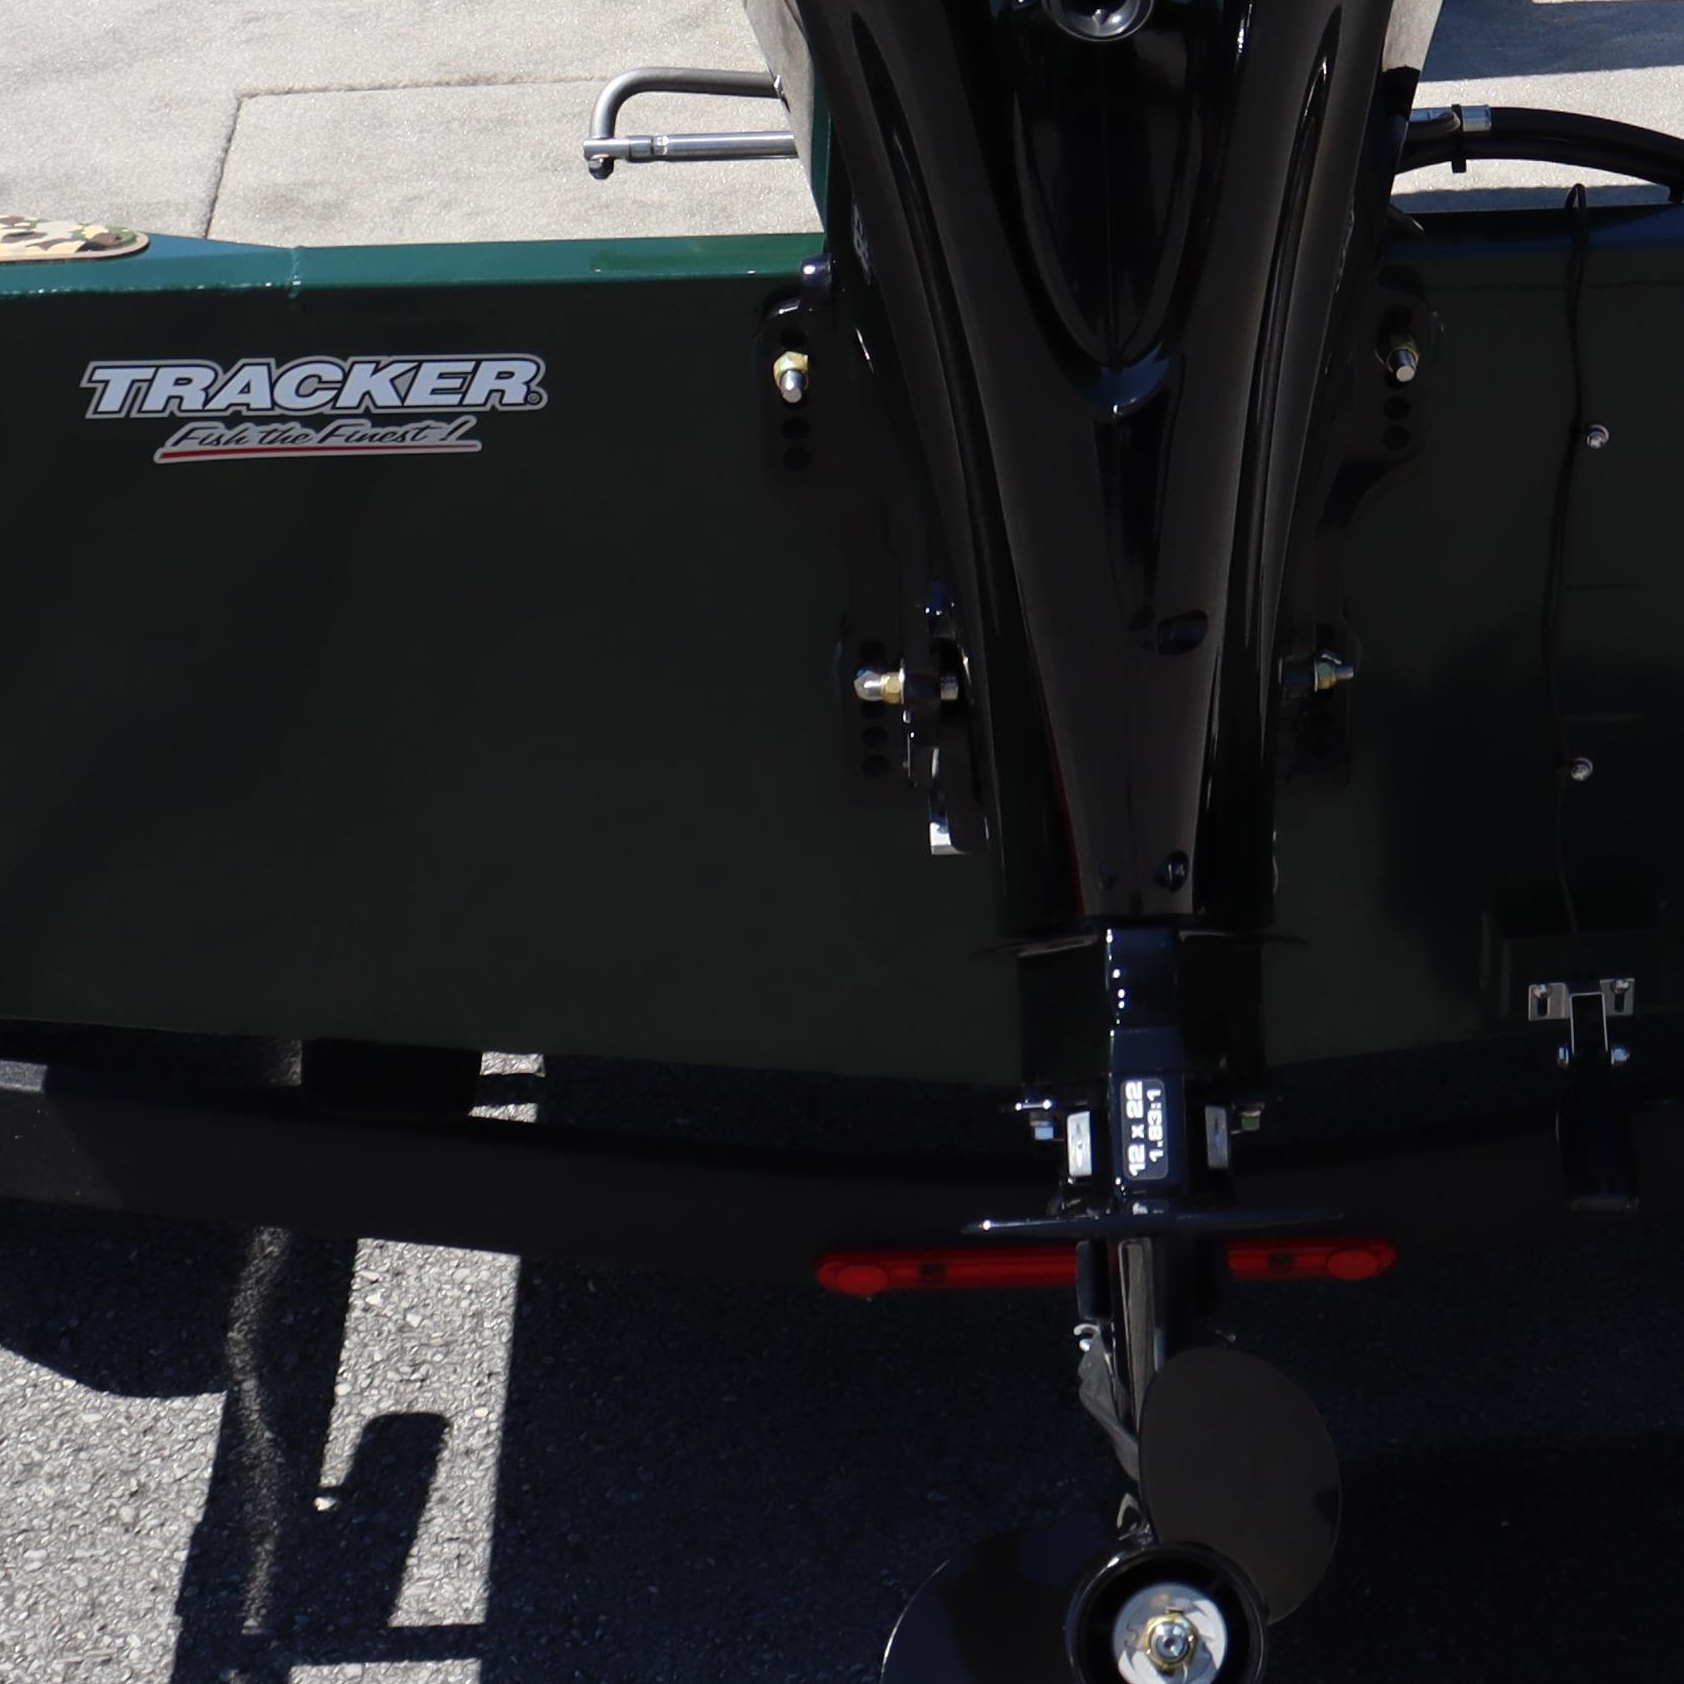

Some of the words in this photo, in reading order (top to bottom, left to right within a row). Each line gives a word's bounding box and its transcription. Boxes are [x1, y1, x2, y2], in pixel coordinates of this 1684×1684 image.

[90, 358, 542, 413] TRACKER
[171, 426, 251, 449] Fish
[256, 424, 311, 446] the
[1146, 1088, 1165, 1163] 1.83:1
[1127, 1144, 1146, 1177] 12
